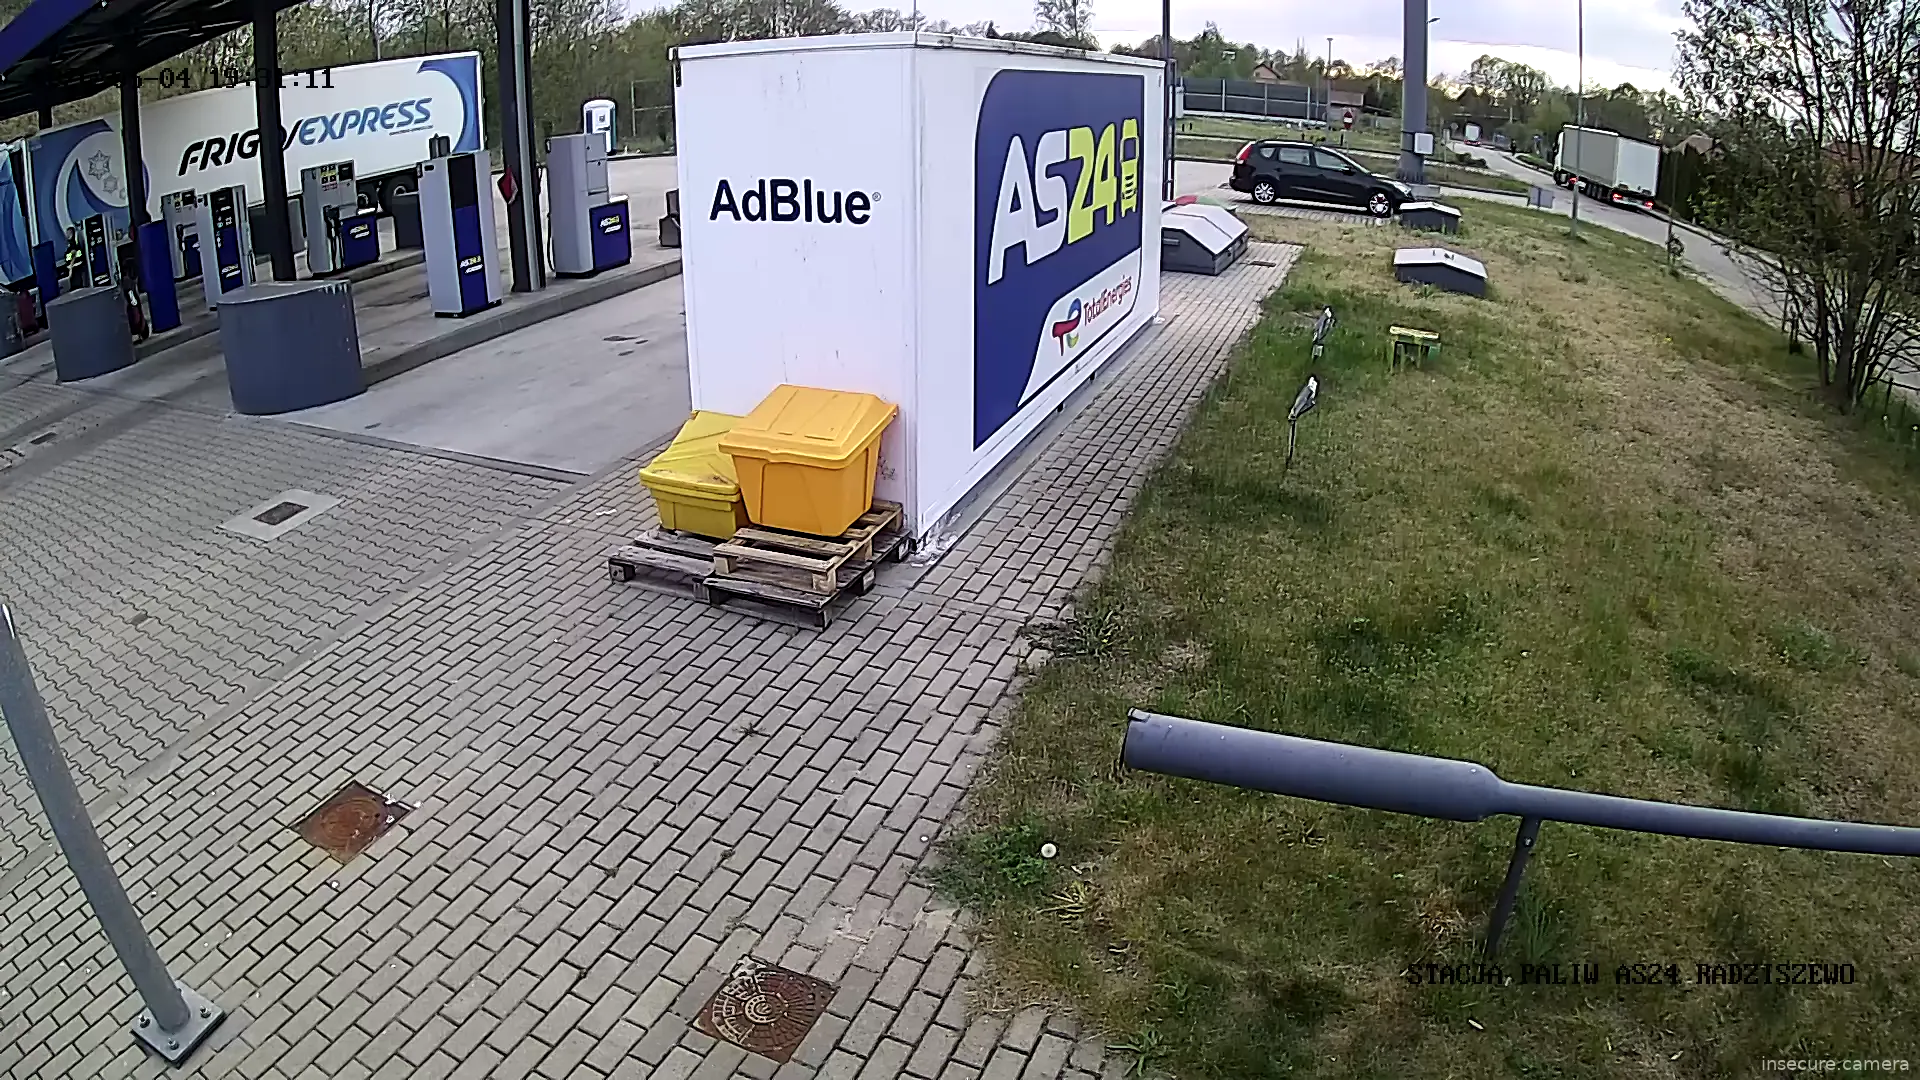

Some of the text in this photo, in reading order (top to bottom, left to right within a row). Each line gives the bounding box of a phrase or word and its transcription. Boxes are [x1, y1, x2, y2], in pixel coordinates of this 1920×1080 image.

[298, 97, 433, 146] EXPRESS
[988, 122, 1118, 285] AS24
[1083, 274, 1132, 327] TotalEnergies
